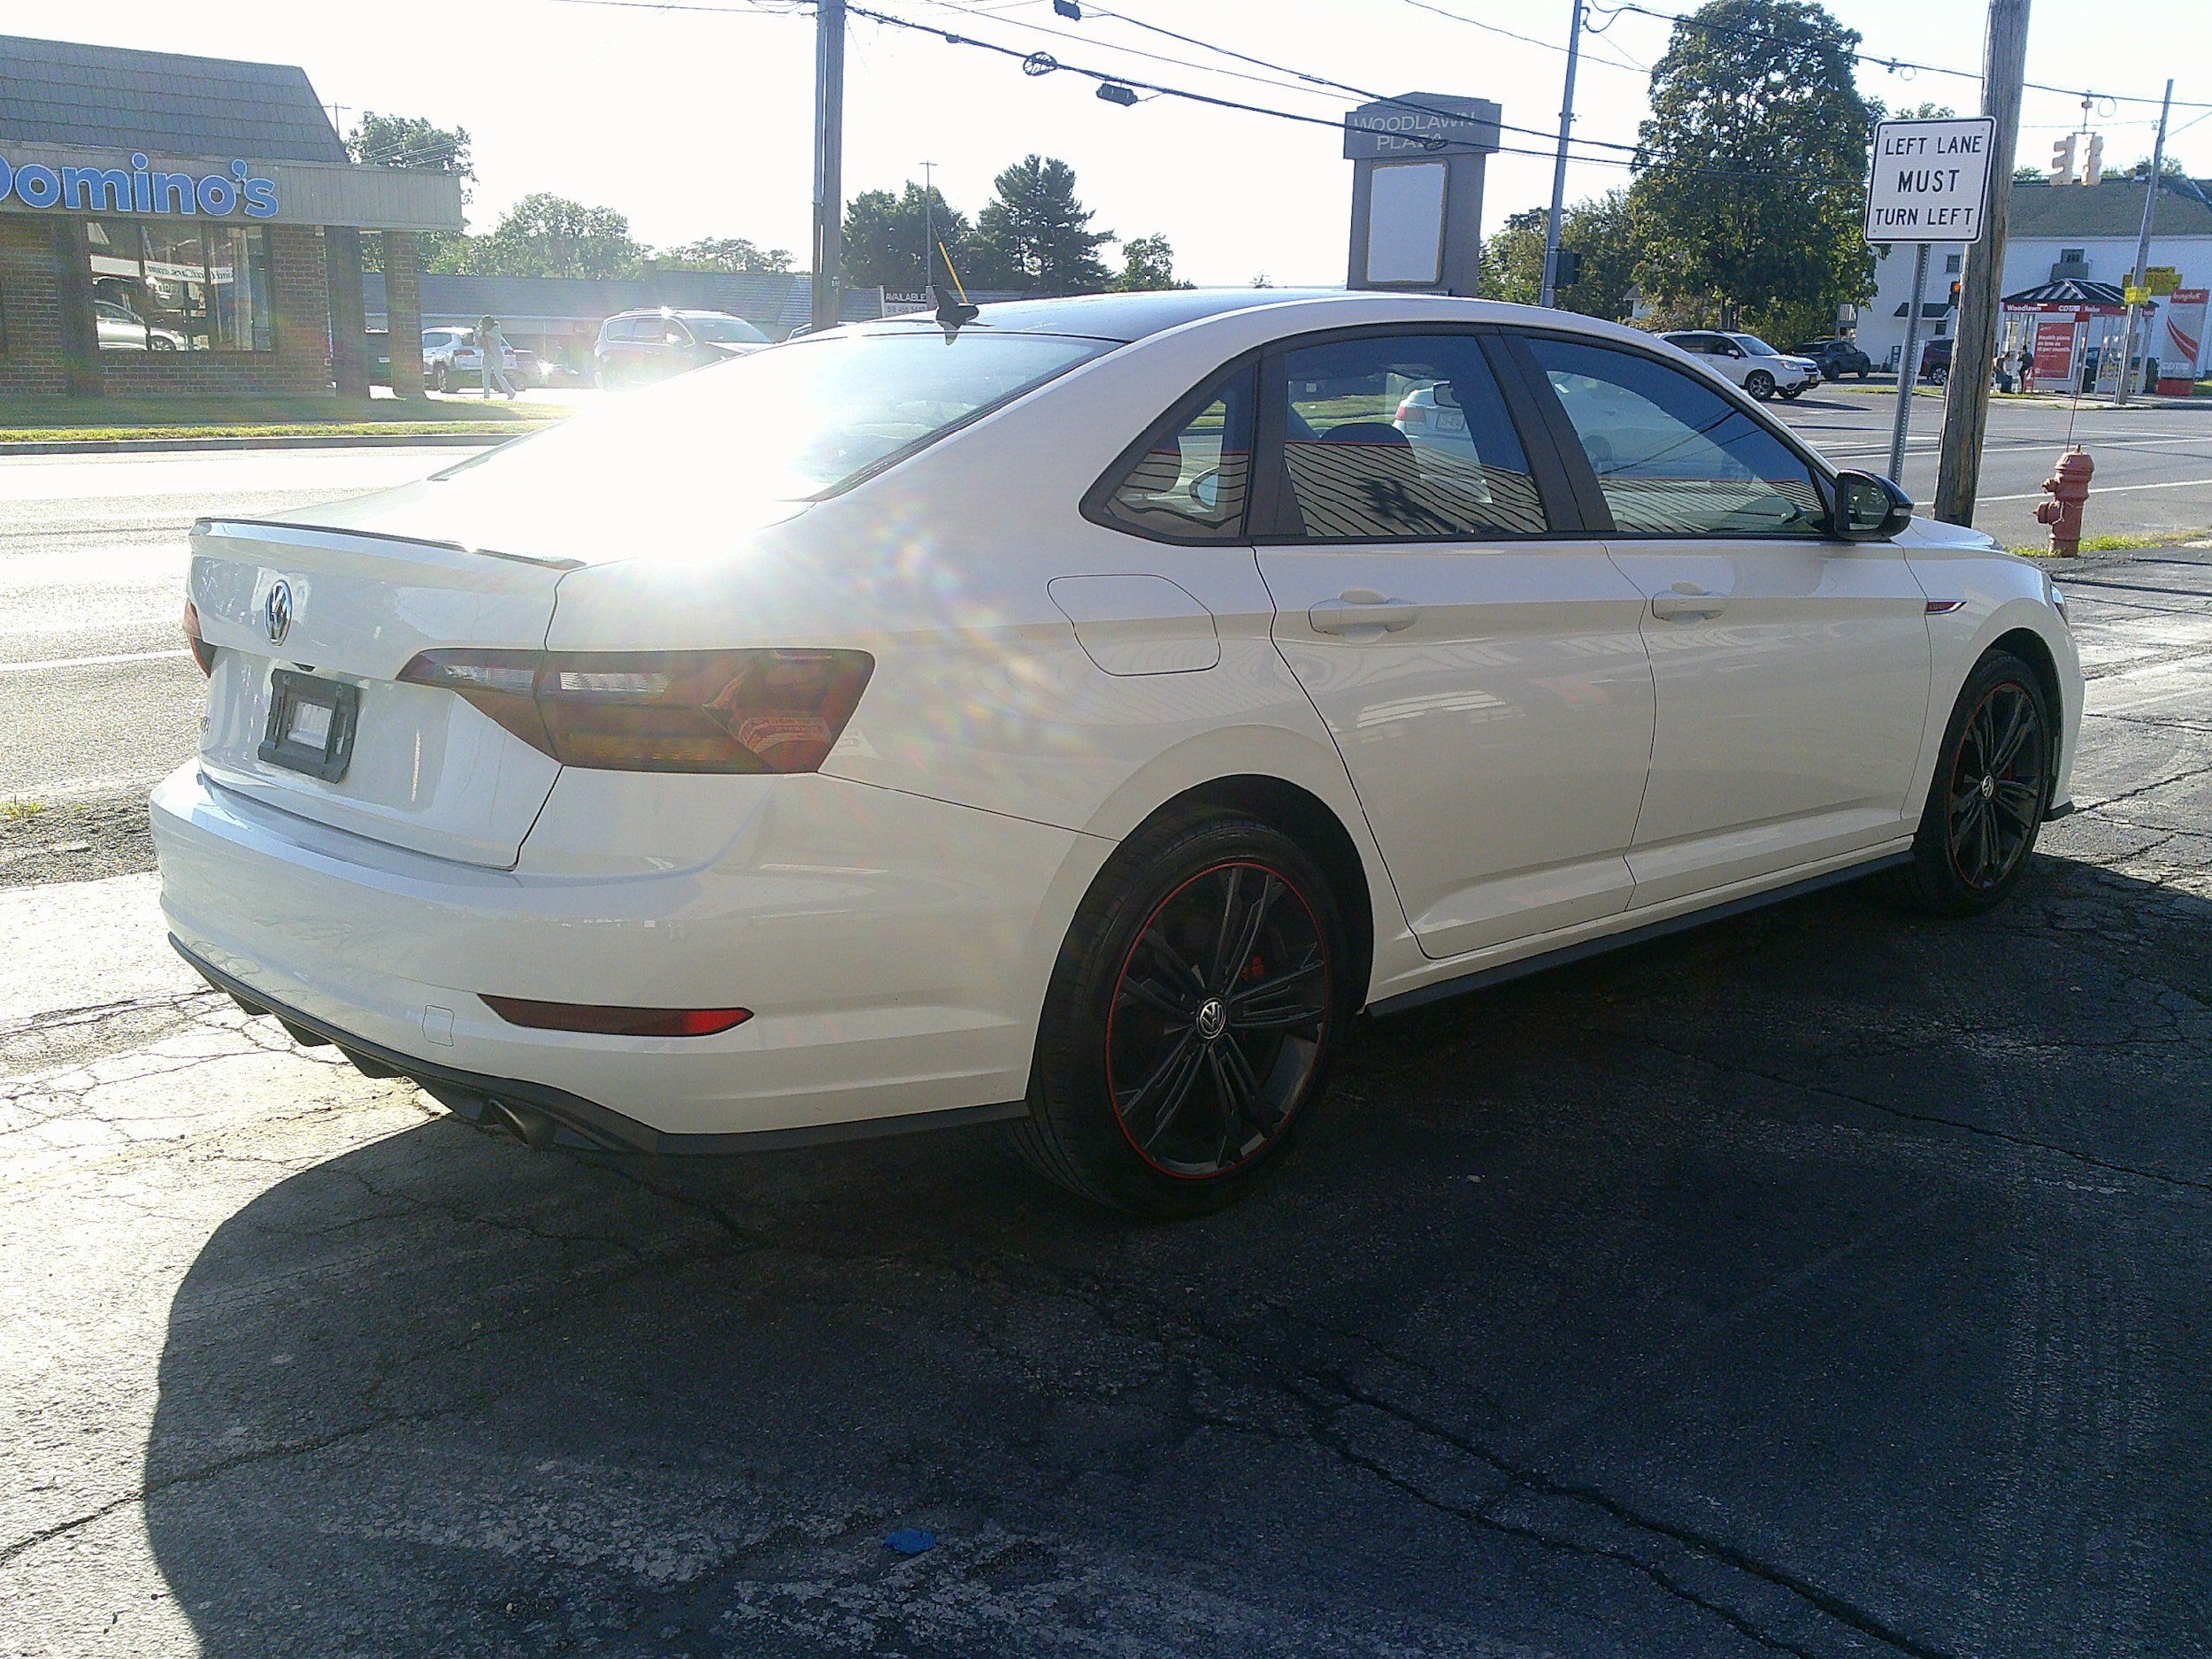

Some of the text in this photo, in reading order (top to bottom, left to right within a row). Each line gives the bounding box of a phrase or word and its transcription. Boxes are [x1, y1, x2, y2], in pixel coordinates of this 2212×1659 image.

[1885, 135, 1983, 155] LEFT LANE
[0, 152, 279, 218] omino's
[1897, 169, 1960, 193] MUST
[1876, 208, 1974, 226] TURN LEFT
[886, 293, 926, 302] AVAILABLE
